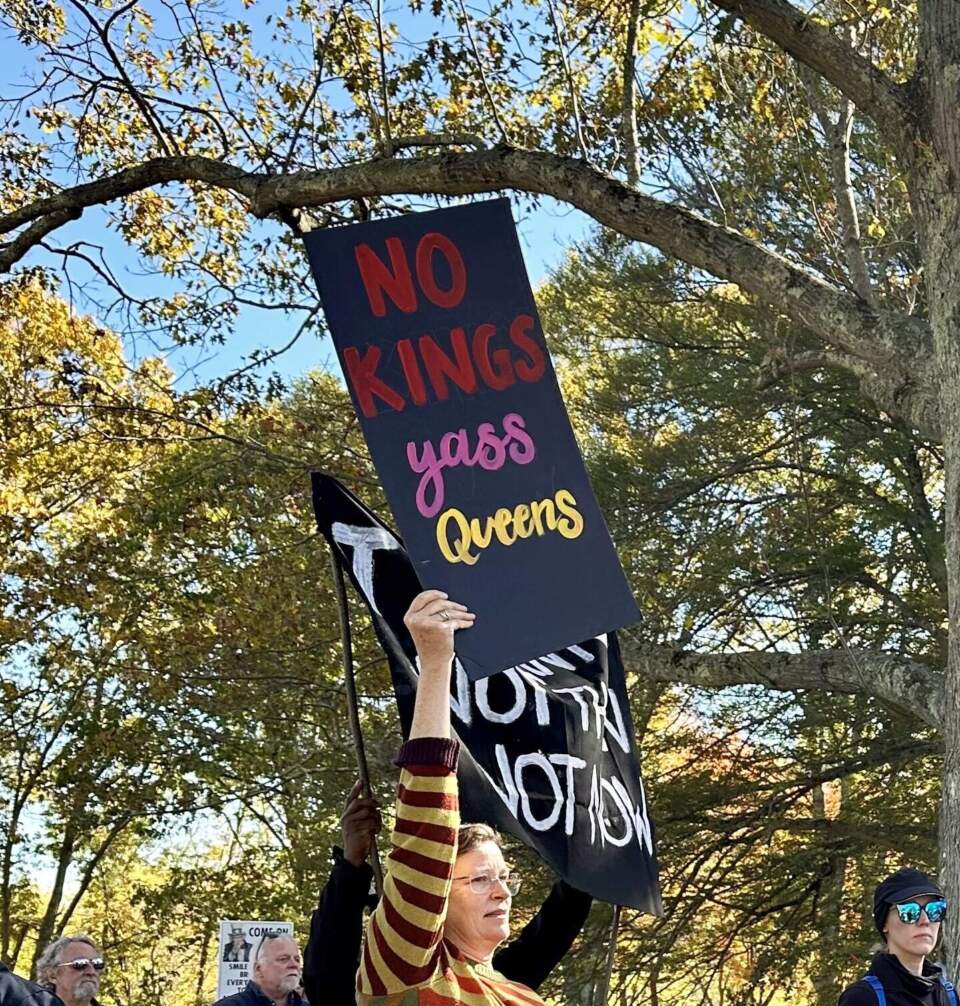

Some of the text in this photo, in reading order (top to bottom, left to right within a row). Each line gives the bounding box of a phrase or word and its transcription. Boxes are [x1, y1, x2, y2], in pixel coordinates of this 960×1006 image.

[354, 232, 467, 318] NO
[343, 314, 545, 418] KINGS
[406, 413, 535, 518] yass
[436, 489, 584, 565] Queens
